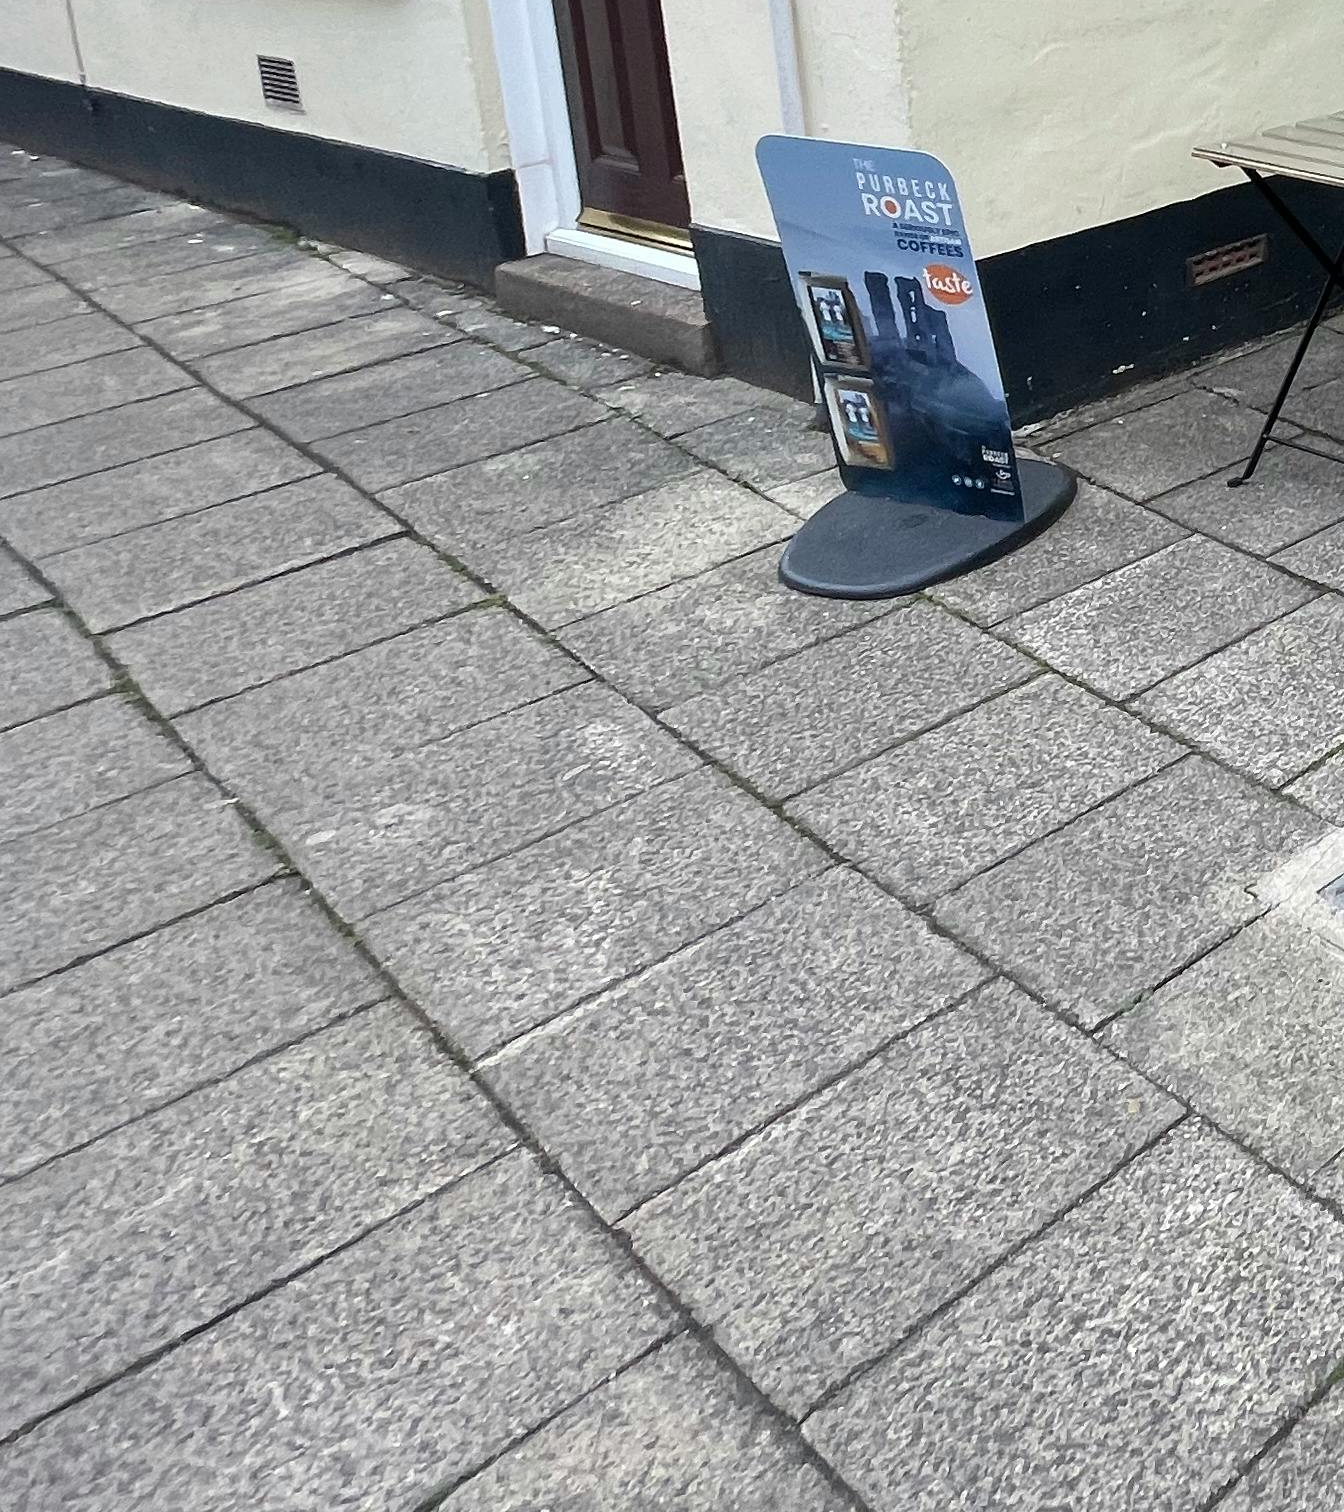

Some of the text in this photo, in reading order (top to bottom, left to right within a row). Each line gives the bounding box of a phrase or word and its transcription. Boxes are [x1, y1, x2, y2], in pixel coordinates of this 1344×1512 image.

[853, 158, 875, 172] THE
[856, 172, 951, 201] PURBECK
[861, 192, 953, 226] ROAST
[897, 238, 964, 258] COFFEES
[922, 268, 974, 295] taste
